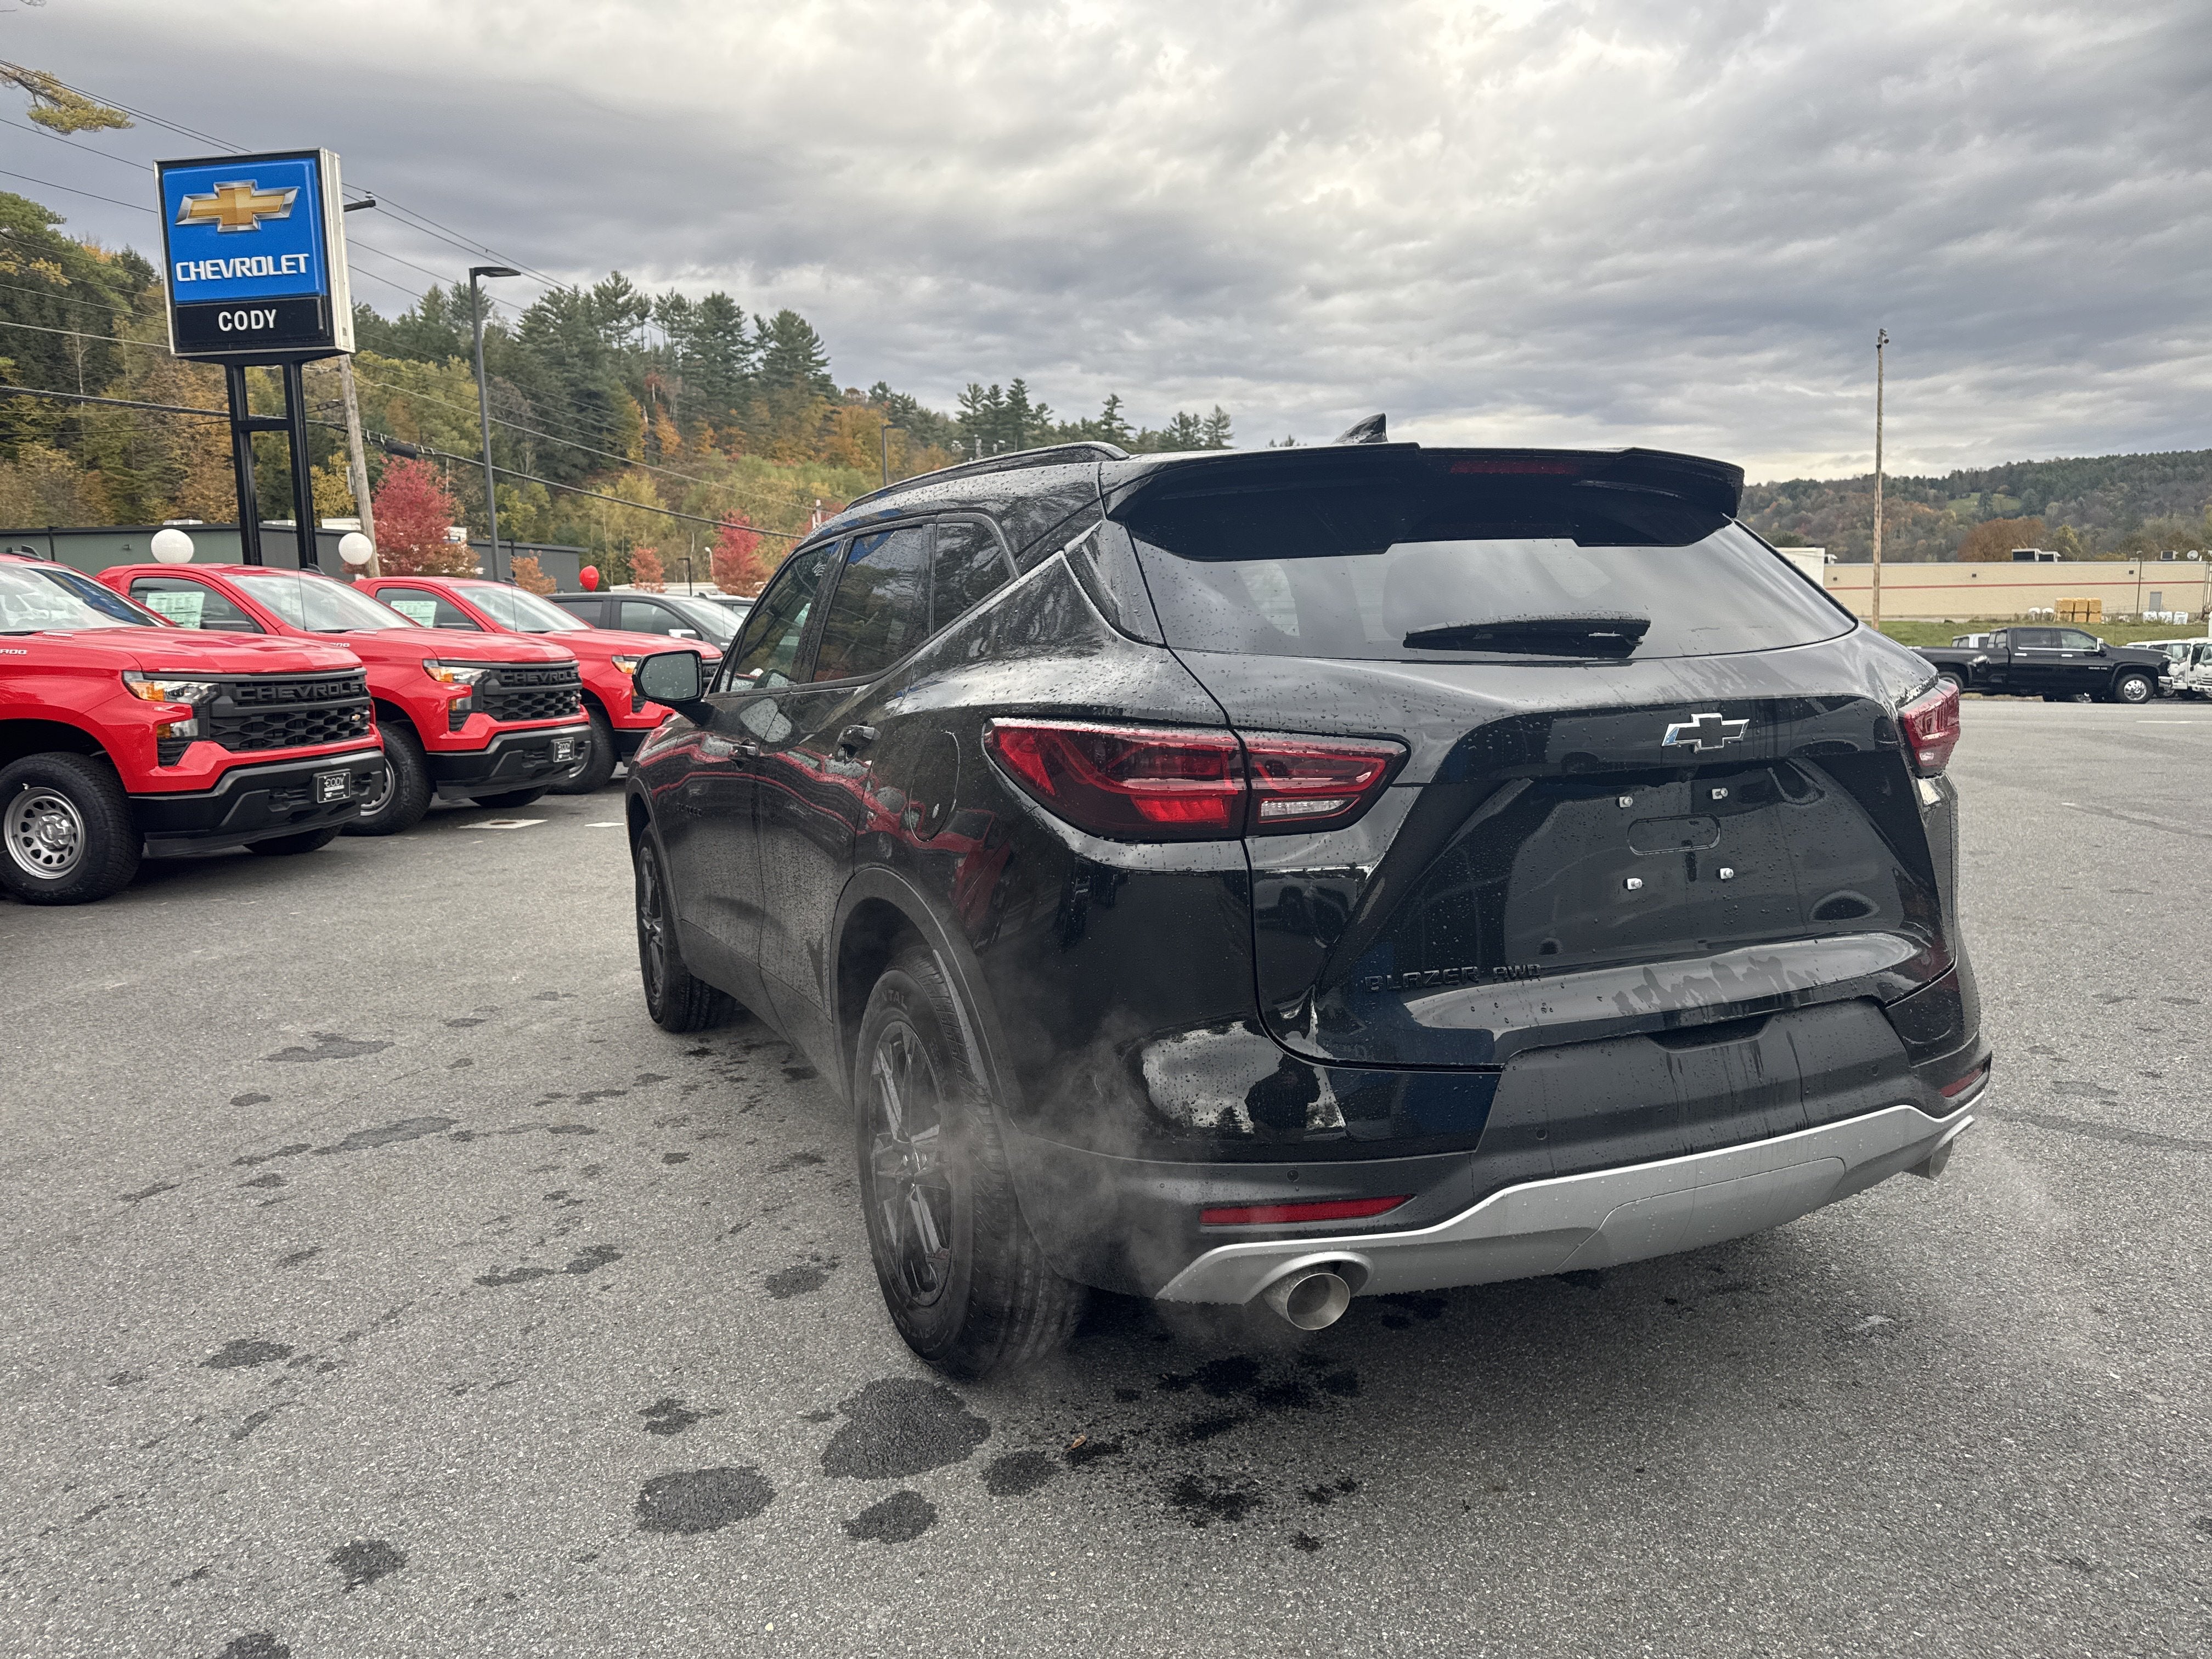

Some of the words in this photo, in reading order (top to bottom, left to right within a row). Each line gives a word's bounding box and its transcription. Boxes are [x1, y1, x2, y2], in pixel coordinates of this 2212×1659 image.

[176, 253, 309, 281] CHEVROLET
[218, 309, 276, 331] CODY
[325, 776, 345, 788] CODY
[1364, 966, 1480, 992] BLAZER
[1492, 963, 1541, 982] AWD
